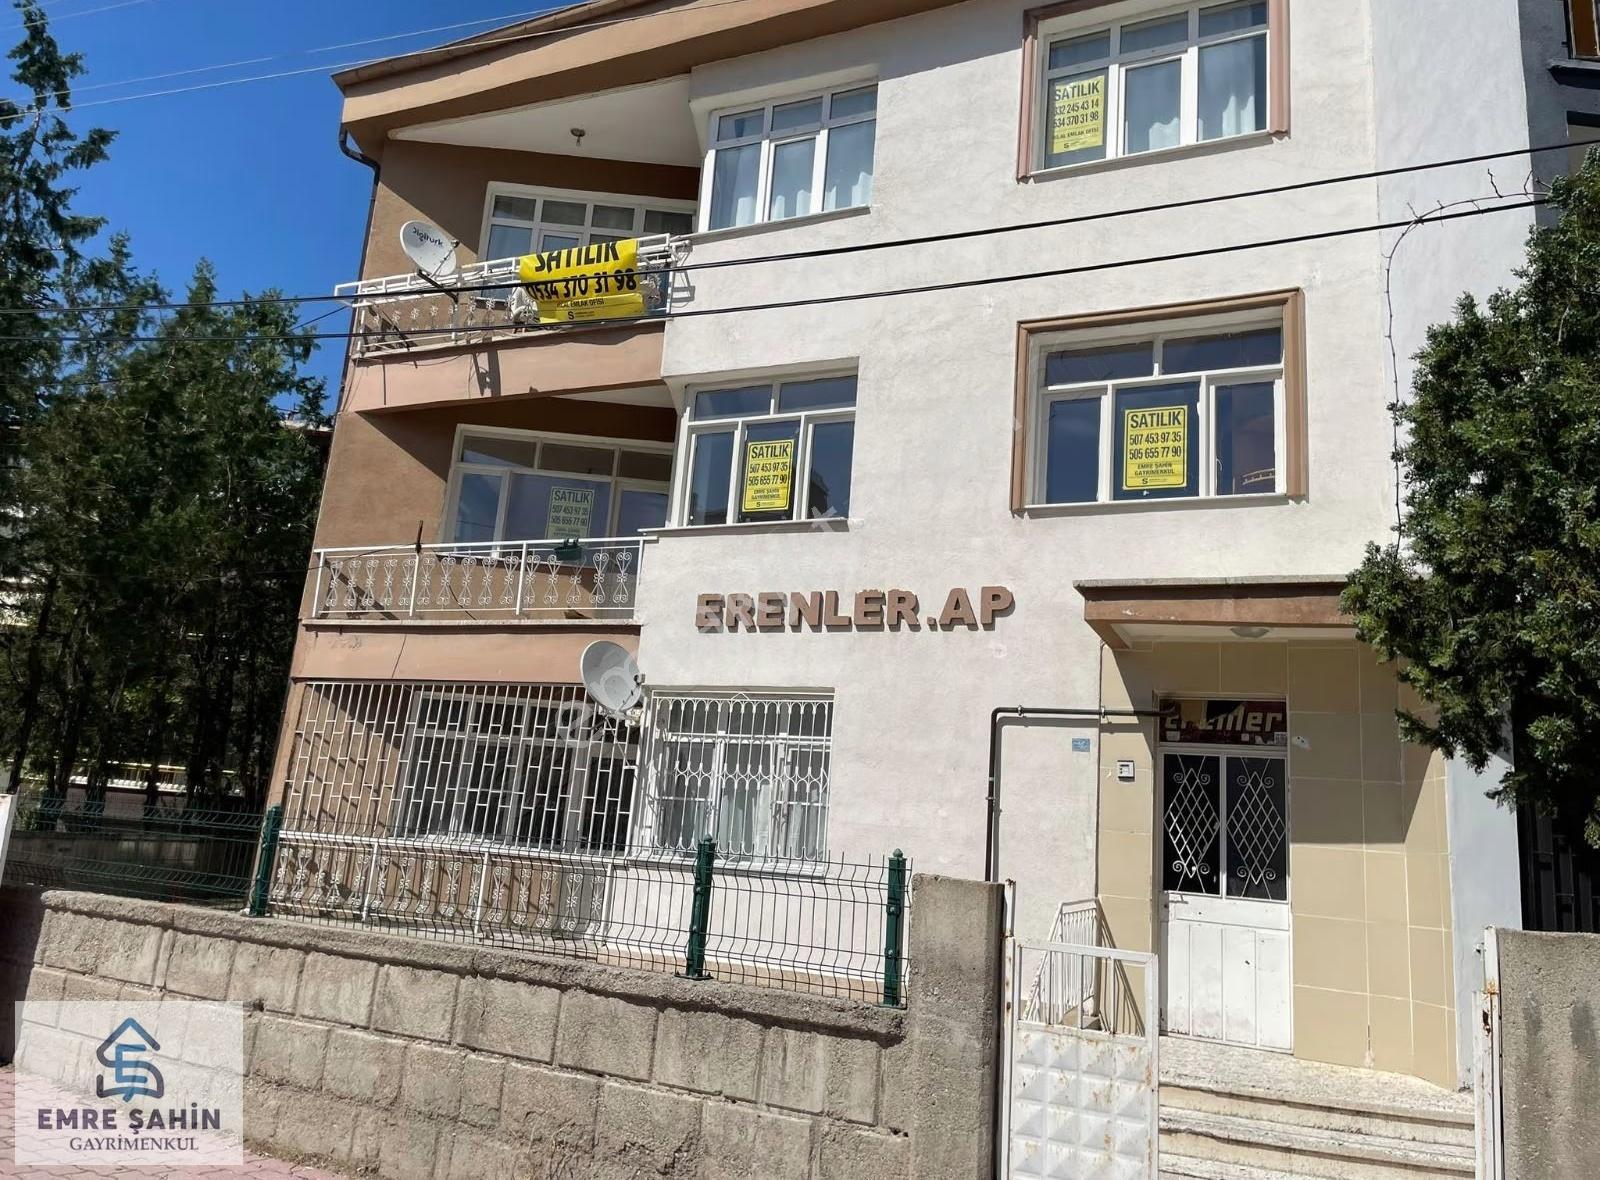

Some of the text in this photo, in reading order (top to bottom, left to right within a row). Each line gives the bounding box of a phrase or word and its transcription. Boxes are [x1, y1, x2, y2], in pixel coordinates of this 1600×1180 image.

[1055, 81, 1100, 101] SATILIK
[1066, 102, 1080, 114] 245
[1080, 99, 1089, 111] 43
[1091, 98, 1099, 109] 14
[1066, 114, 1080, 126] 370
[1080, 112, 1088, 124] 31
[1090, 110, 1099, 122] 98
[535, 241, 620, 273] SATILIK
[563, 273, 589, 298] 370
[594, 270, 609, 294] 31
[614, 267, 637, 291] 98
[1130, 411, 1182, 429] SATILIK
[1129, 431, 1182, 446] 507 453 97 35
[751, 444, 789, 459] SATILIK
[1129, 446, 1182, 460] 505 655 77 90
[553, 490, 590, 503] SATILIK
